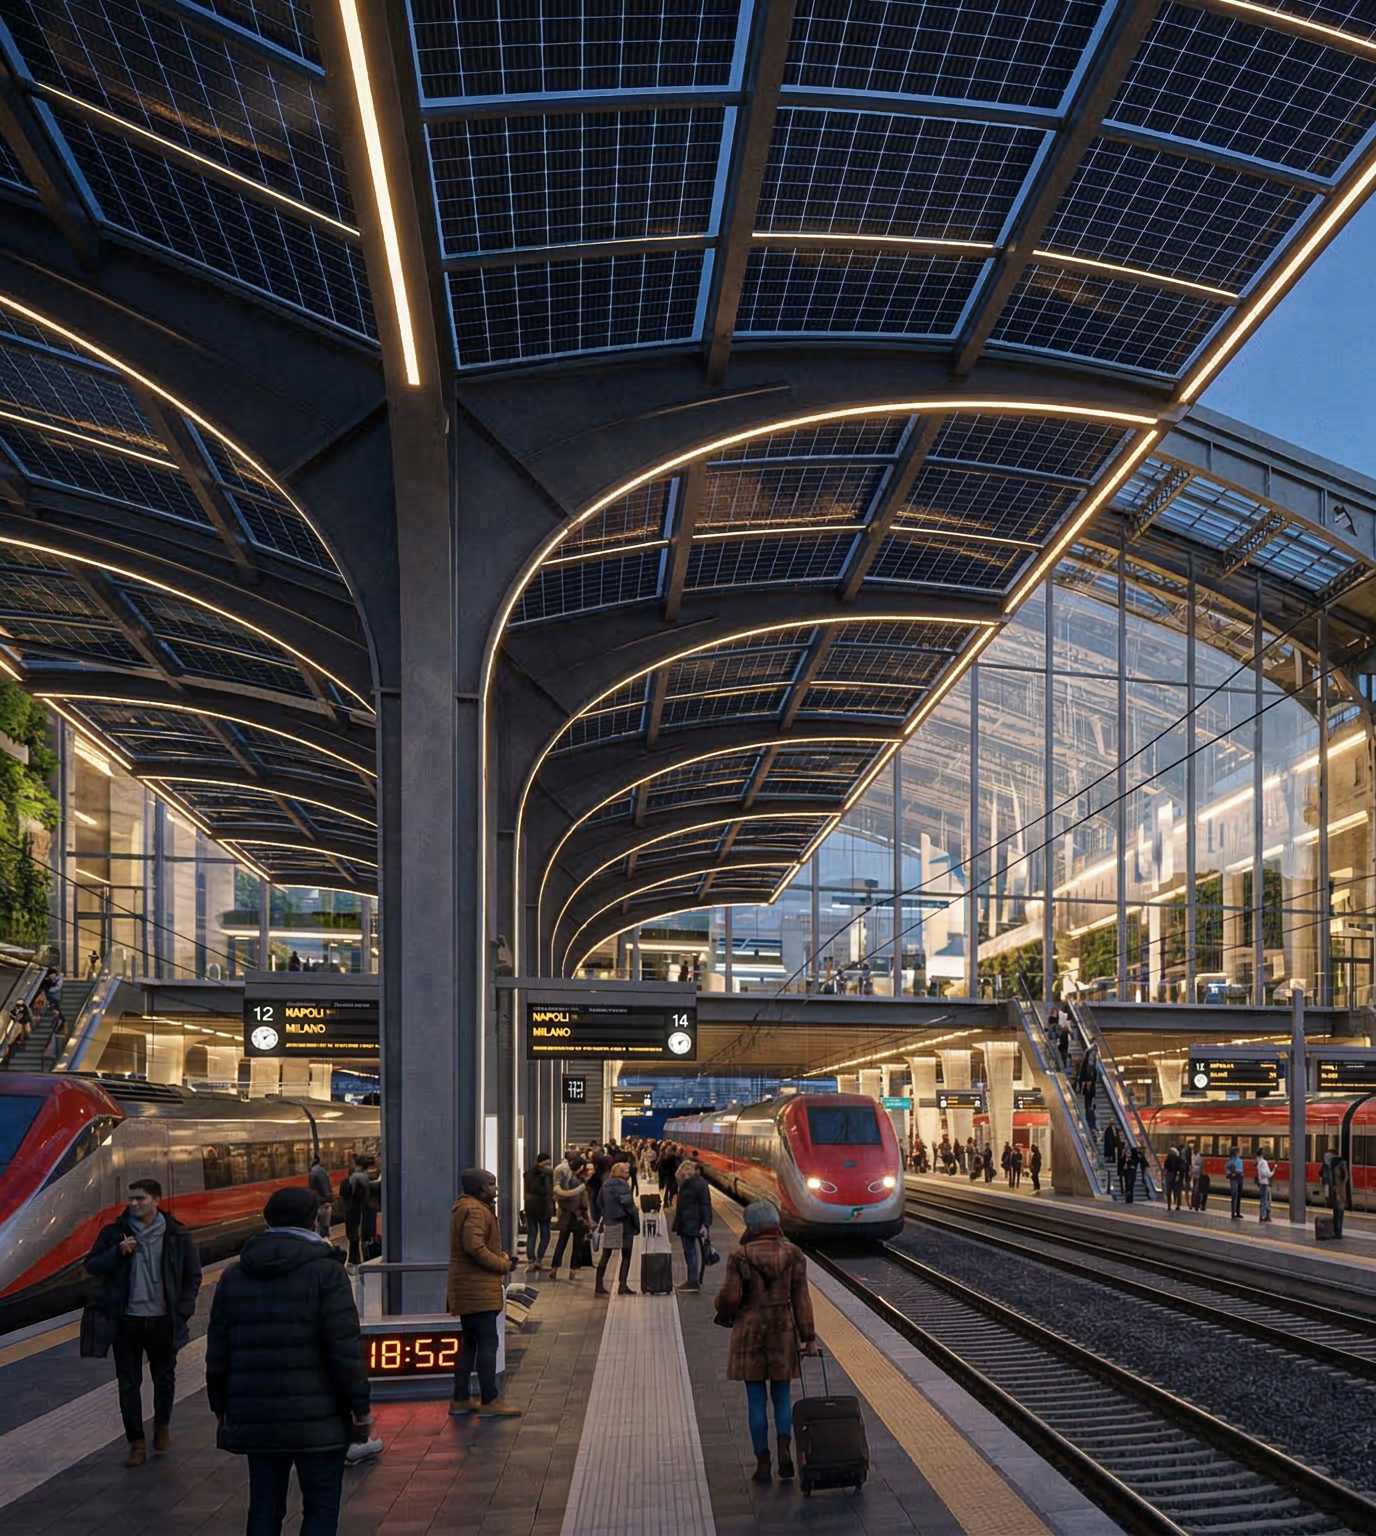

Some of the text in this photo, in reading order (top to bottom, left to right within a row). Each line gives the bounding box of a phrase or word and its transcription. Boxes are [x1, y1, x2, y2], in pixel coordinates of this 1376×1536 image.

[253, 1006, 274, 1021] 12
[532, 1012, 570, 1022] NAPOLI
[672, 1013, 689, 1027] 14
[370, 1338, 459, 1369] 18:52
